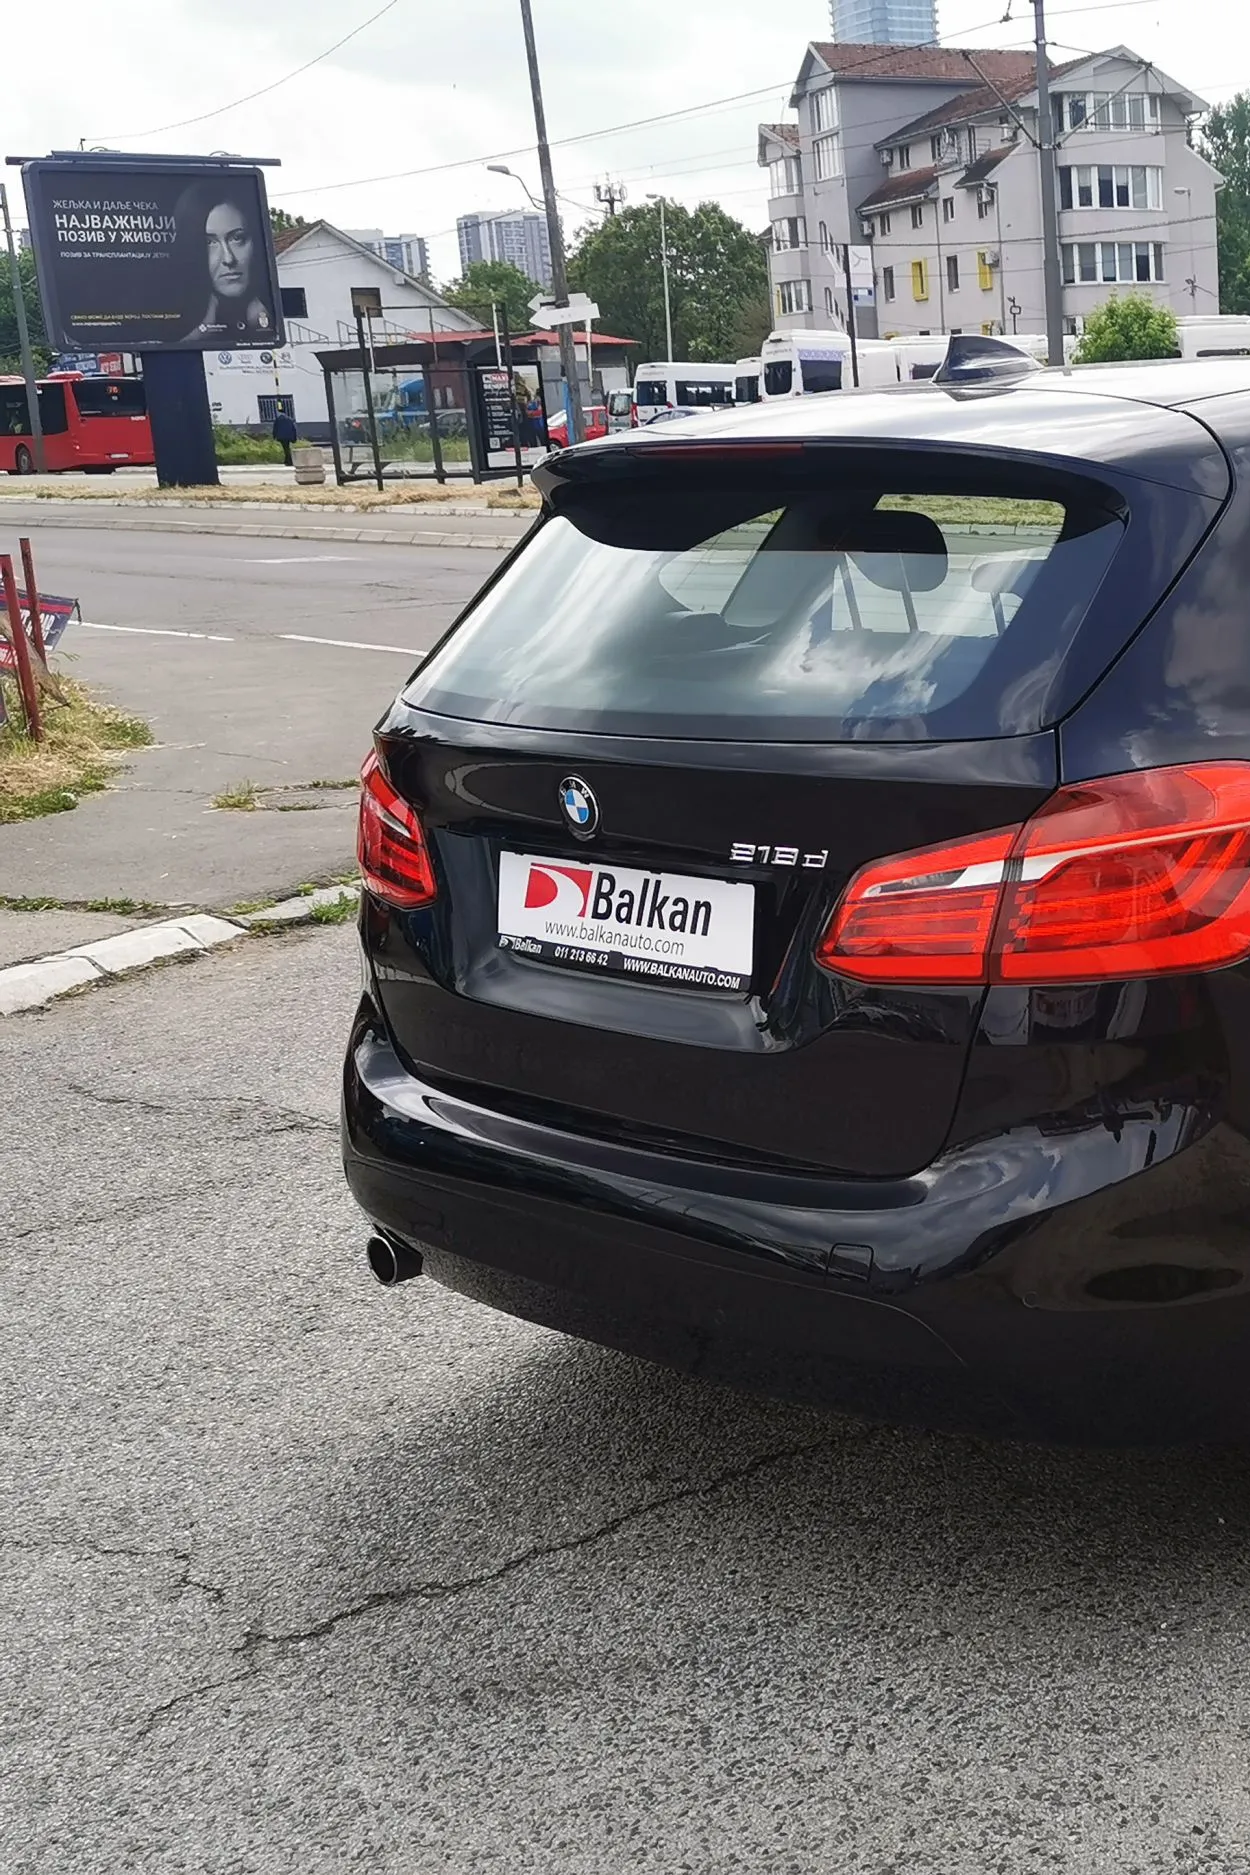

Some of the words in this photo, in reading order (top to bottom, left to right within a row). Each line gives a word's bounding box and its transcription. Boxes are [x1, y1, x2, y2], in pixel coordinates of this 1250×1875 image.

[52, 200, 92, 209] ЖЕЉКА
[93, 201, 101, 209] И
[102, 201, 132, 211] ДАЉЕ
[133, 202, 159, 210] ЧЕКА
[55, 214, 177, 230] НАЈВАЖНИЈИ
[57, 231, 106, 242] ПОЗИВ
[108, 232, 117, 243] У
[120, 232, 177, 243] ЖИВОТУ
[591, 871, 712, 937] Balkan
[544, 920, 685, 956] www.balkanauto.com
[514, 937, 543, 954] Balkan
[554, 945, 569, 959] 011
[570, 948, 585, 962] 213
[597, 953, 609, 966] 42
[623, 958, 741, 989] WWW.BALKANAUTO.COM
